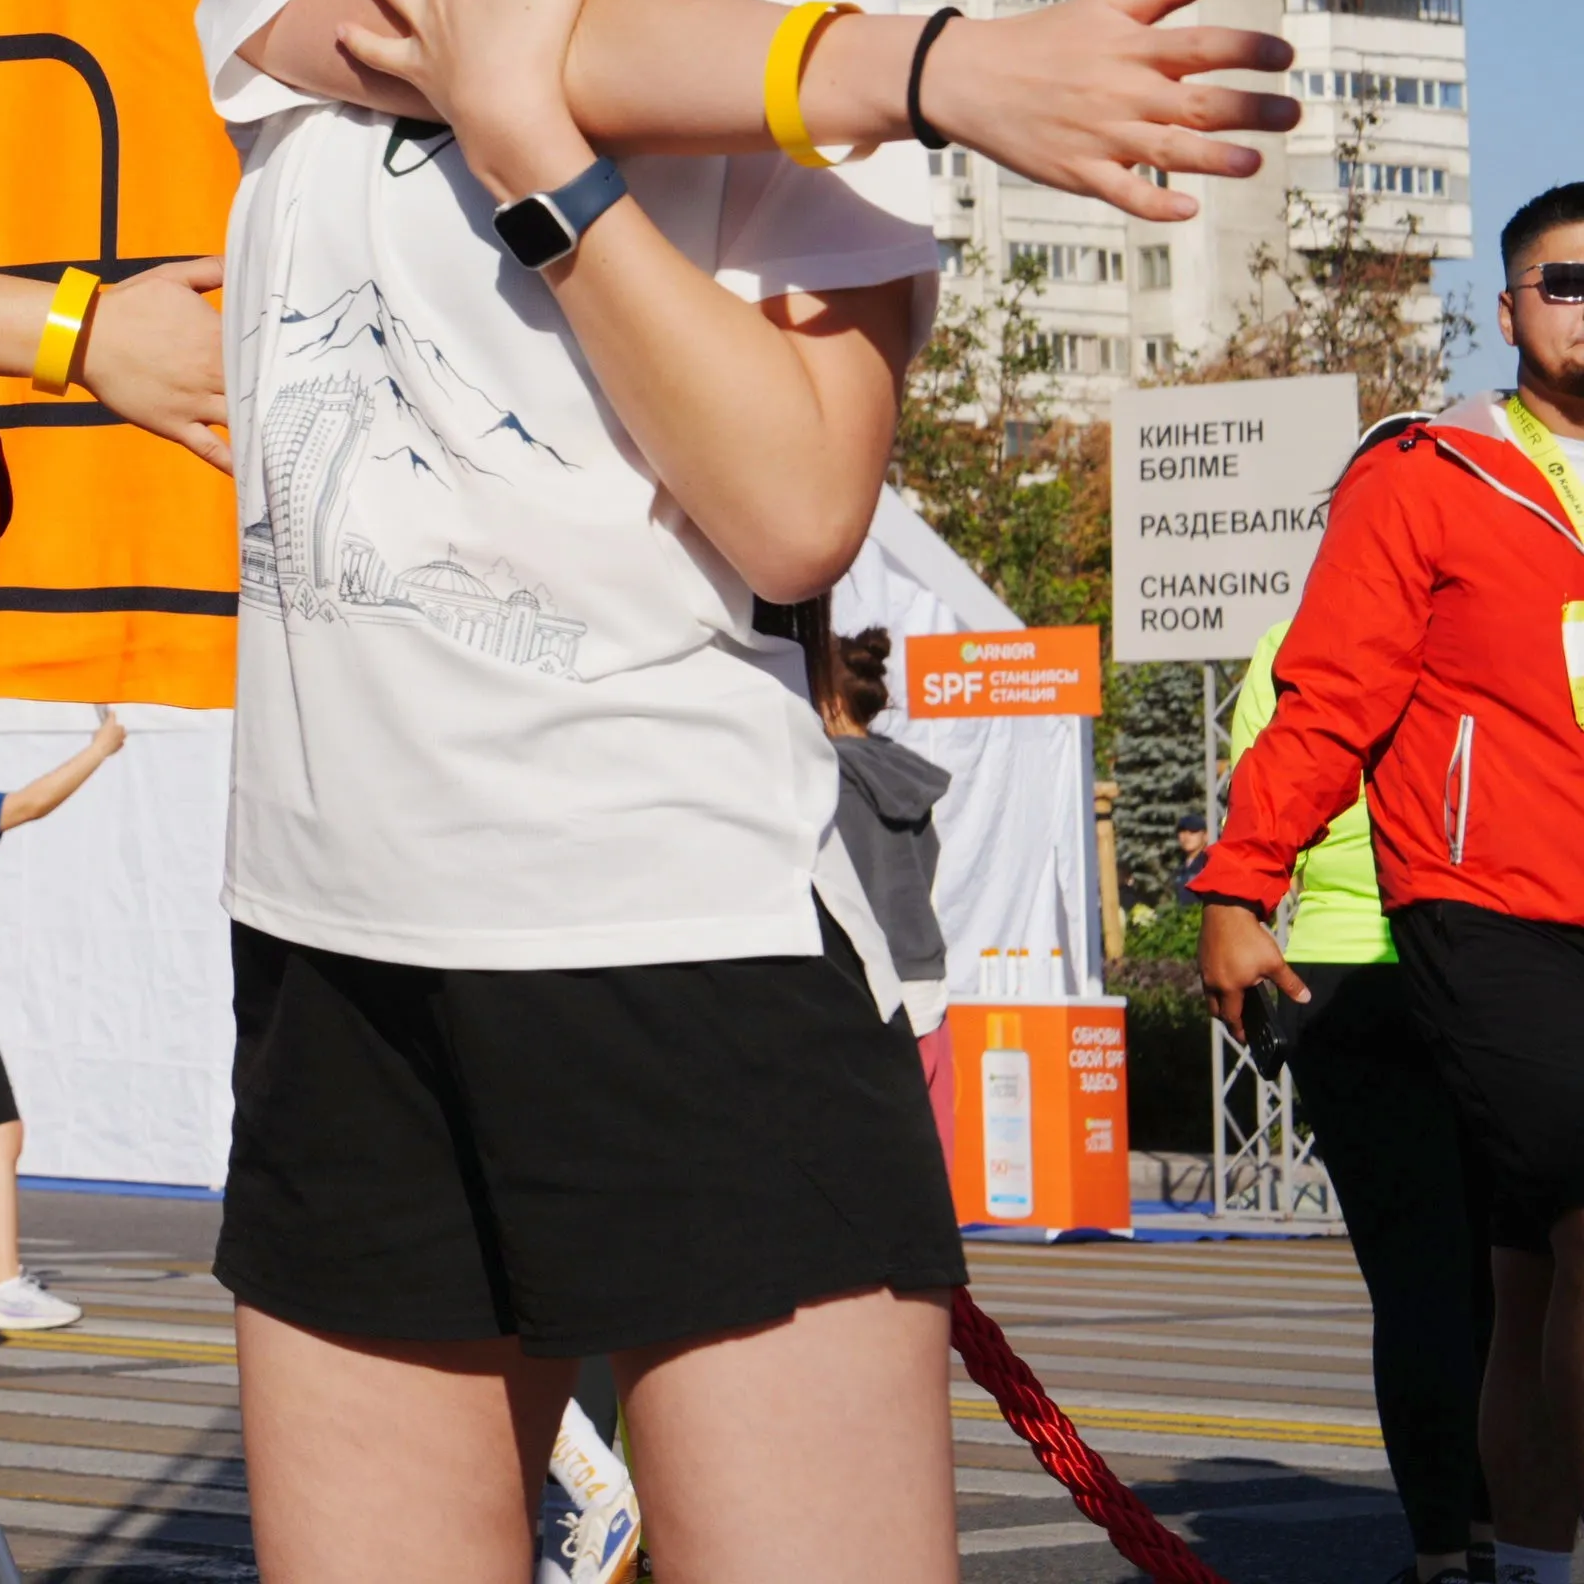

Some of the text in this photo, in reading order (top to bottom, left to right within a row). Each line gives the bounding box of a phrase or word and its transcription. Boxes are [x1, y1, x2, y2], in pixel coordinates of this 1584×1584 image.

[1139, 419, 1264, 449] КИІНЕТІН
[1139, 454, 1239, 482] БӨЛМЕ
[1140, 507, 1326, 540] РАЗДЕВАЛКА
[1140, 570, 1291, 599] CHANGING
[1141, 606, 1223, 633] ROOM
[923, 671, 984, 706] SPF
[989, 687, 1056, 704] СТАНЦИЯ
[1072, 1026, 1121, 1046] ОБНОВИ
[1069, 1047, 1104, 1068] СВОЙ
[1079, 1072, 1119, 1093] ЗДЕСЬ
